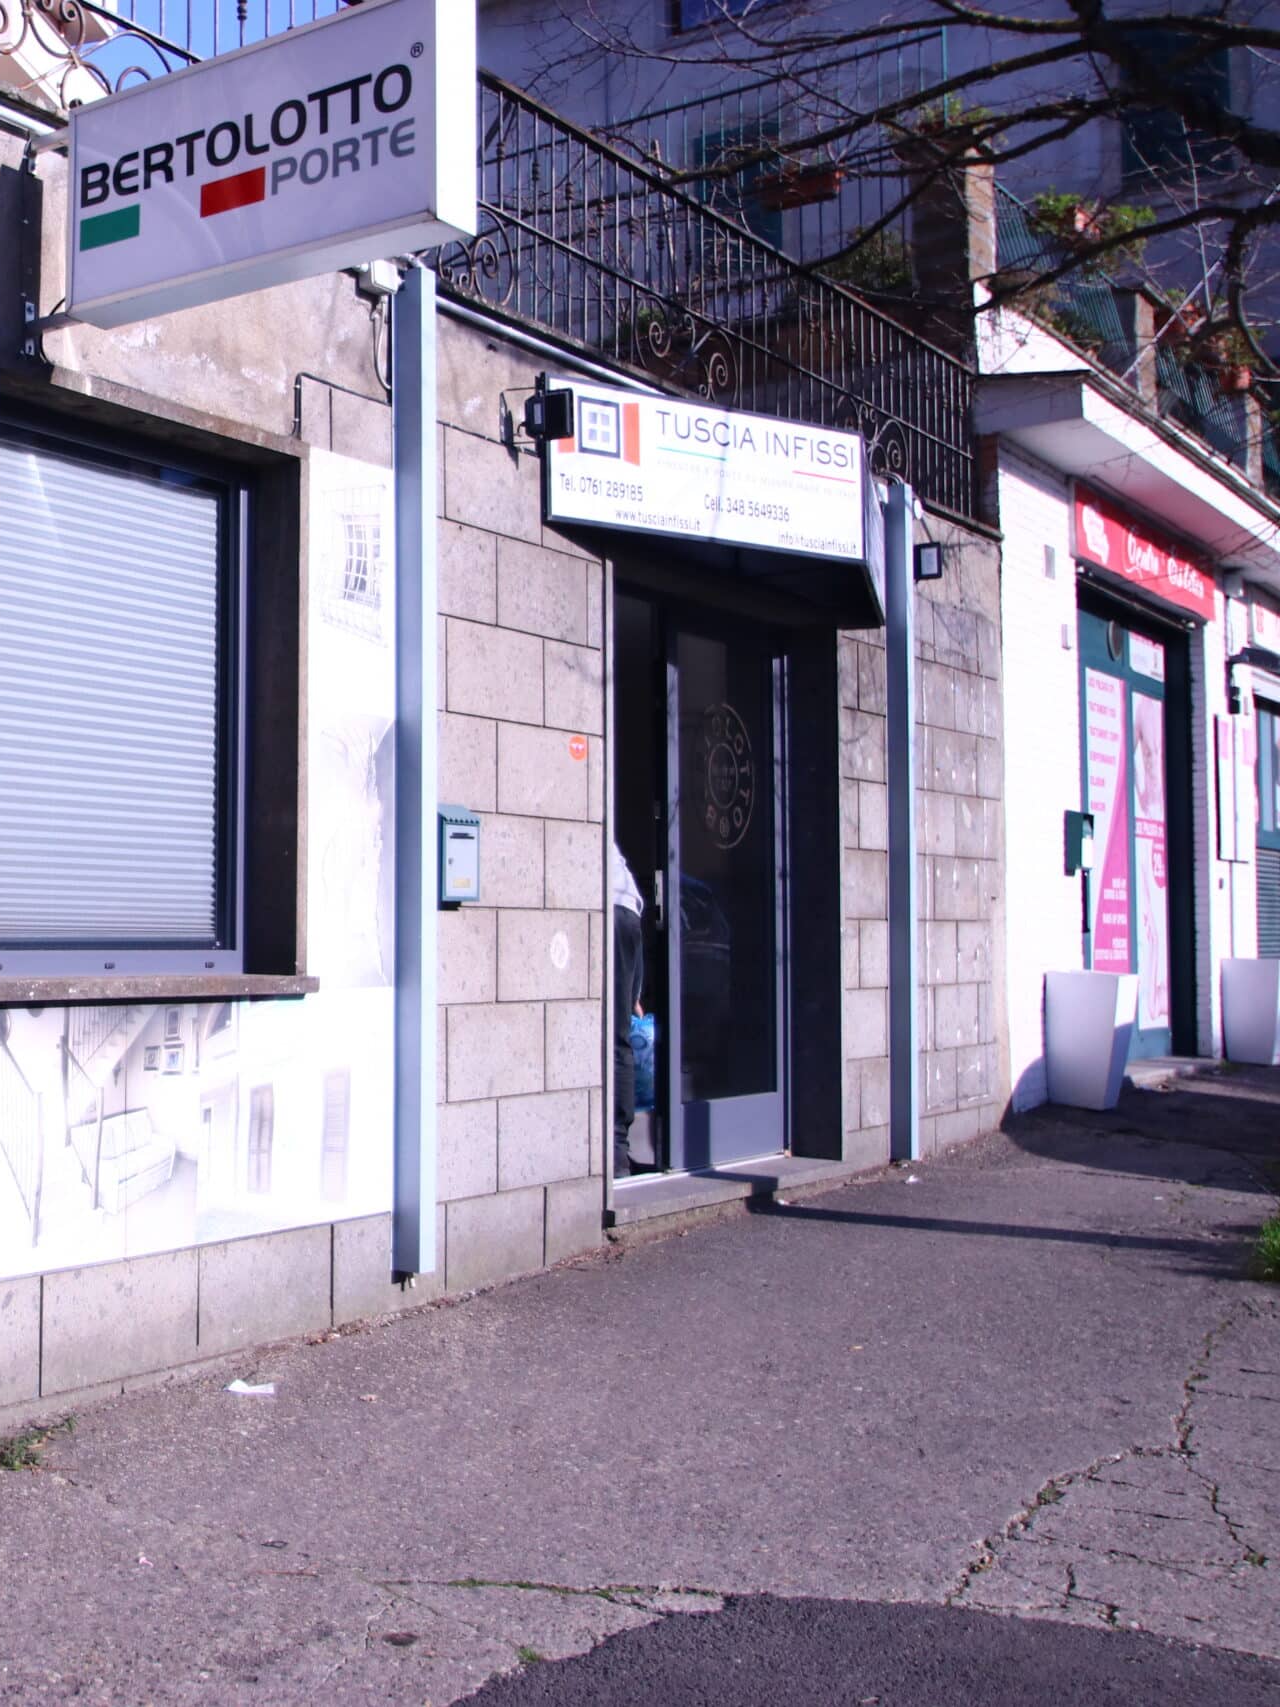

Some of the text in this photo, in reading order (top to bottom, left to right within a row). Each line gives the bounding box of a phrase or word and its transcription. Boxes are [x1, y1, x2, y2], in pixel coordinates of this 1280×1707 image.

[80, 63, 412, 209] BERTOLOTTO
[271, 118, 415, 196] PORTE
[655, 410, 856, 470] TUSCIA INFISSI
[560, 472, 643, 502] Tel. 0761 289185
[704, 493, 791, 523] Cell. 348 5649336
